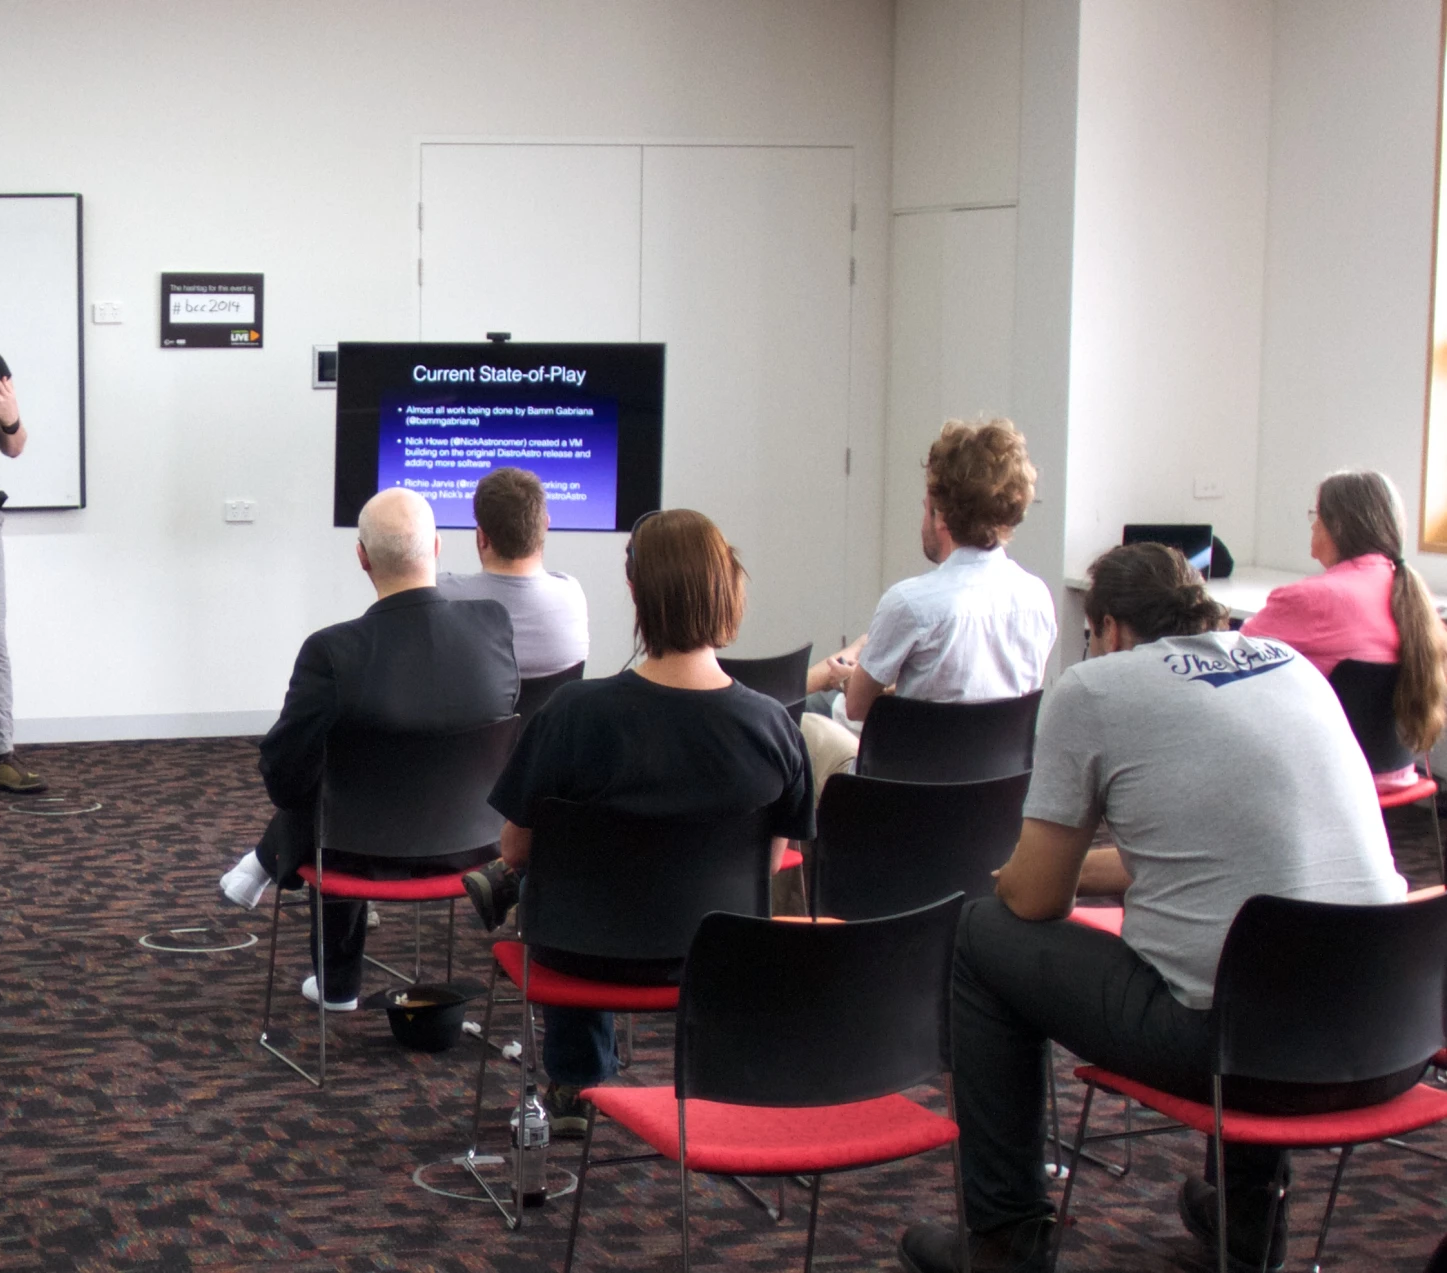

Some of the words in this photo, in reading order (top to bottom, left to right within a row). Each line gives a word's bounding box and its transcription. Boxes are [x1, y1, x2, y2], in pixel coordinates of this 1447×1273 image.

[170, 284, 182, 292] The
[231, 334, 249, 342] LIVE
[413, 364, 475, 383] Current
[479, 365, 587, 386] State-of-Play
[406, 406, 434, 415] Almost
[435, 406, 445, 415] all
[446, 406, 466, 415] work
[467, 406, 491, 417] being
[492, 407, 513, 415] done
[515, 407, 526, 417] by
[527, 407, 554, 415] Bamm
[555, 407, 594, 416] Gabriana
[405, 416, 480, 427] (@bammgabriana)
[405, 437, 424, 446] Nick
[425, 437, 448, 446] Howe
[450, 437, 527, 448] (@NickAstronomer)
[528, 438, 560, 448] created
[561, 440, 567, 448] a
[569, 438, 583, 447] VM
[405, 448, 437, 458] building
[451, 448, 464, 457] the
[465, 448, 496, 459] original
[497, 448, 541, 458] DistroAstro
[543, 449, 573, 458] release
[575, 449, 591, 459] and
[404, 458, 434, 469] adding
[435, 460, 456, 468] more
[457, 459, 492, 468] software
[404, 478, 430, 488] Richie
[431, 479, 455, 489] Jarvis
[542, 480, 568, 491] orking
[569, 482, 581, 490] on
[438, 490, 463, 499] Nick's
[1163, 653, 1227, 675] The
